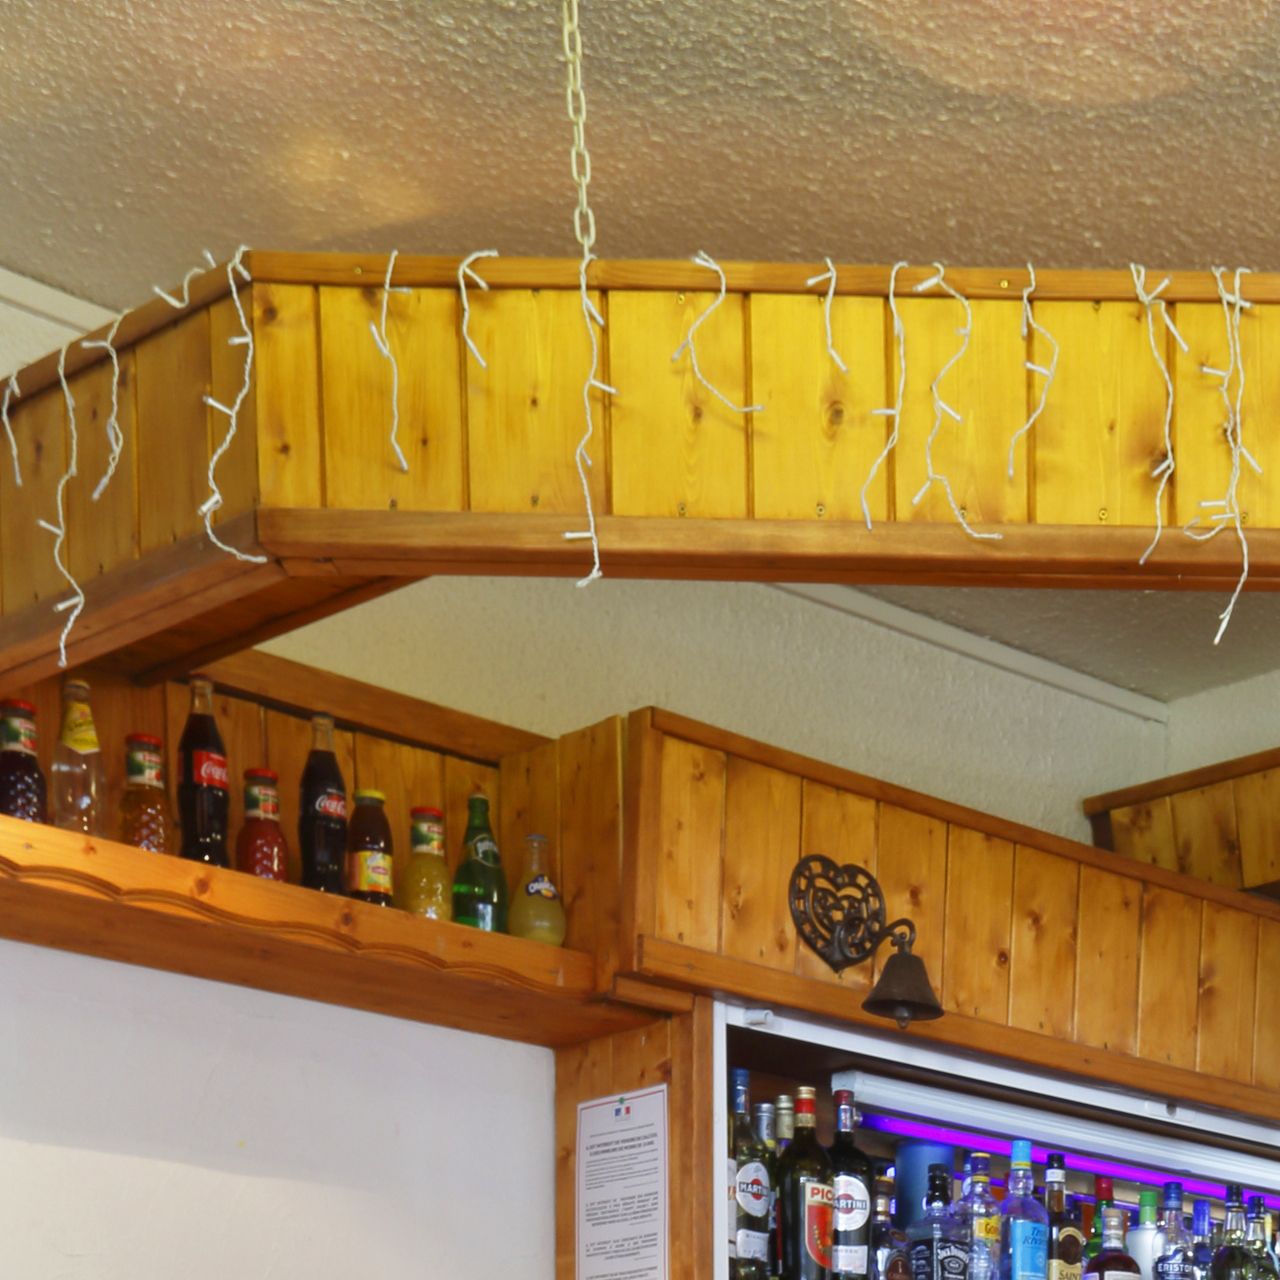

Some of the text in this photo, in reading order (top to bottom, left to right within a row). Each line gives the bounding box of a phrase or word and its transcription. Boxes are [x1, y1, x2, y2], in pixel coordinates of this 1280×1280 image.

[810, 1186, 833, 1201] PIC
[834, 1198, 867, 1210] ARTINI
[1158, 1263, 1193, 1273] ERISTO
